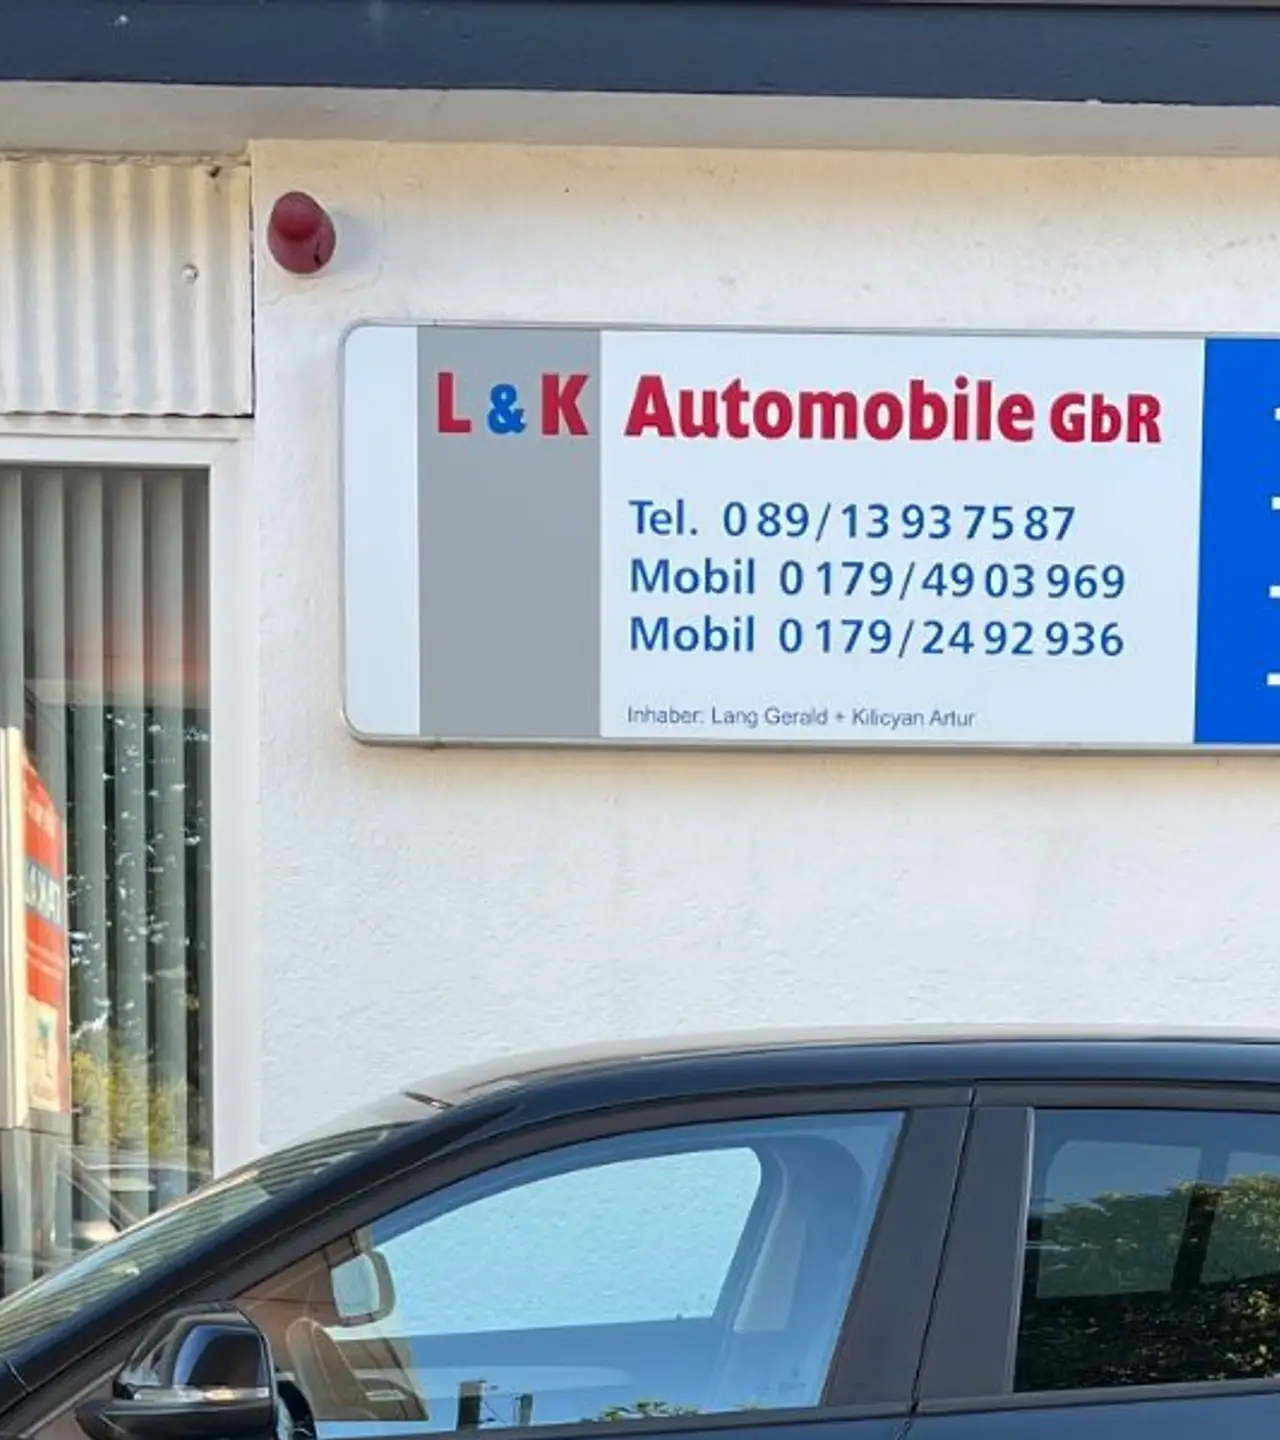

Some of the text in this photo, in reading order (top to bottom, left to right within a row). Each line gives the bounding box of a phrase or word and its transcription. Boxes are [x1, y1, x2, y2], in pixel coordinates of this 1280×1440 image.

[438, 373, 1161, 444] L & K Automobile GbR
[630, 498, 700, 537] Tel.
[630, 556, 757, 596] Mobil
[629, 614, 756, 654] Mobil
[711, 706, 758, 729] Lang
[764, 707, 828, 726] Gerald
[929, 709, 975, 727] Artur
